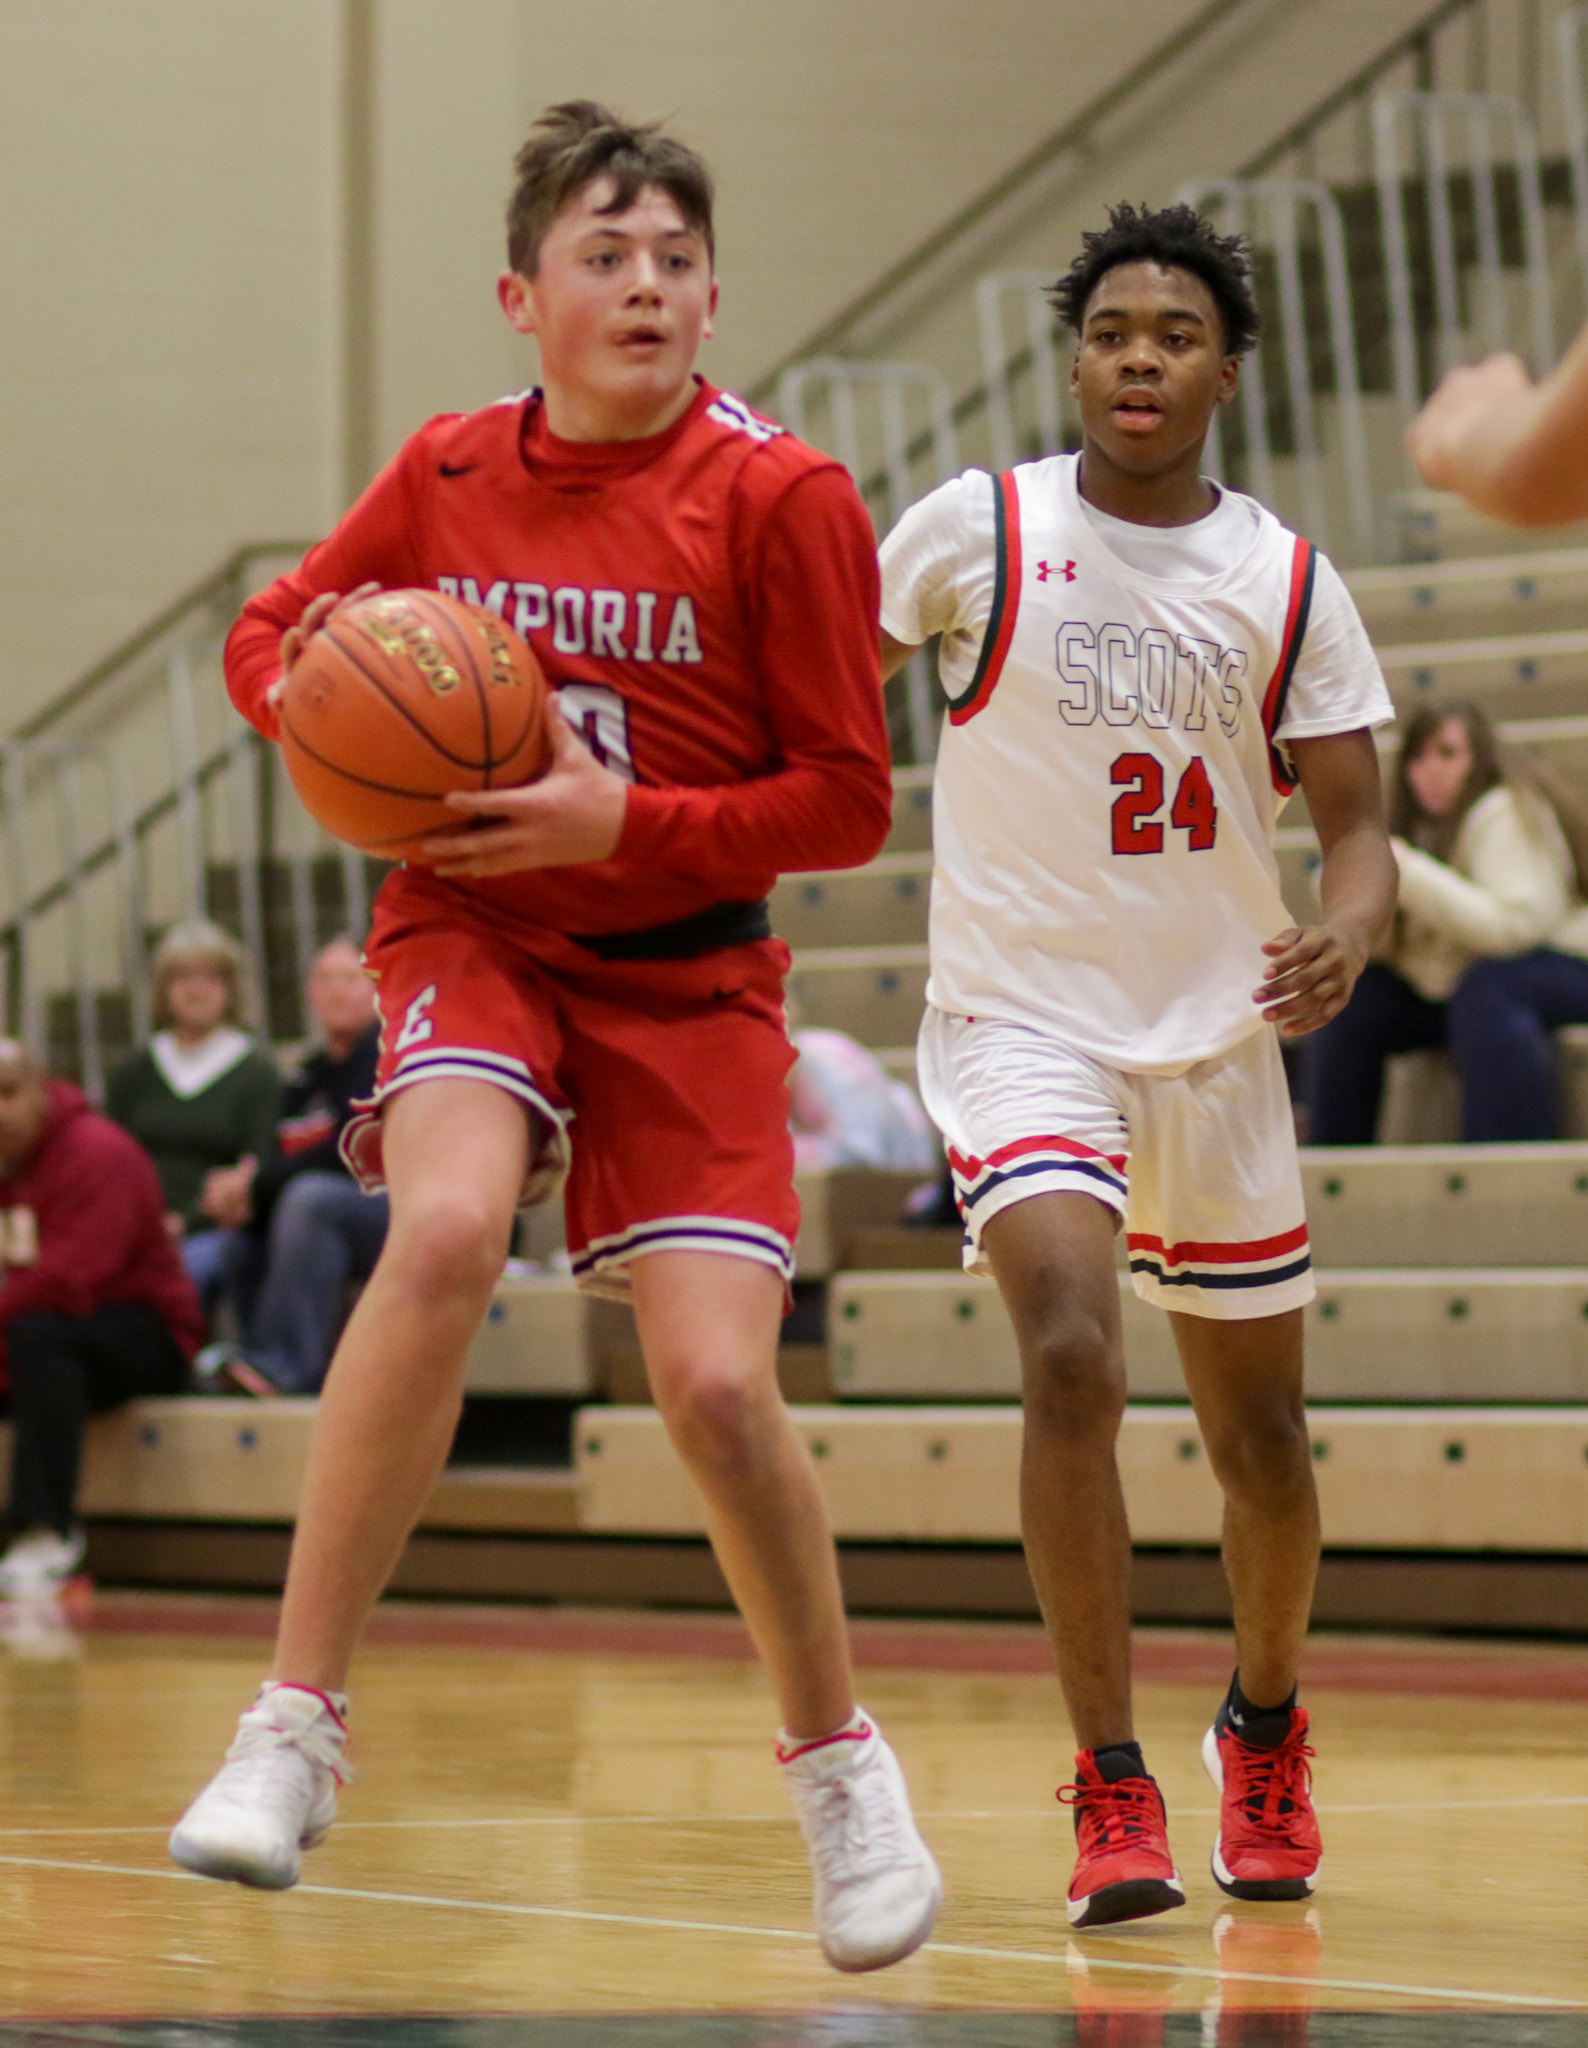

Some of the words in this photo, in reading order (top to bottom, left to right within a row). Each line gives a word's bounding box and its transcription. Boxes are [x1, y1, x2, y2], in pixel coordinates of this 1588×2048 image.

[1055, 621, 1249, 739] SCOTS
[1109, 752, 1218, 856] 24
[393, 983, 437, 1054] E
